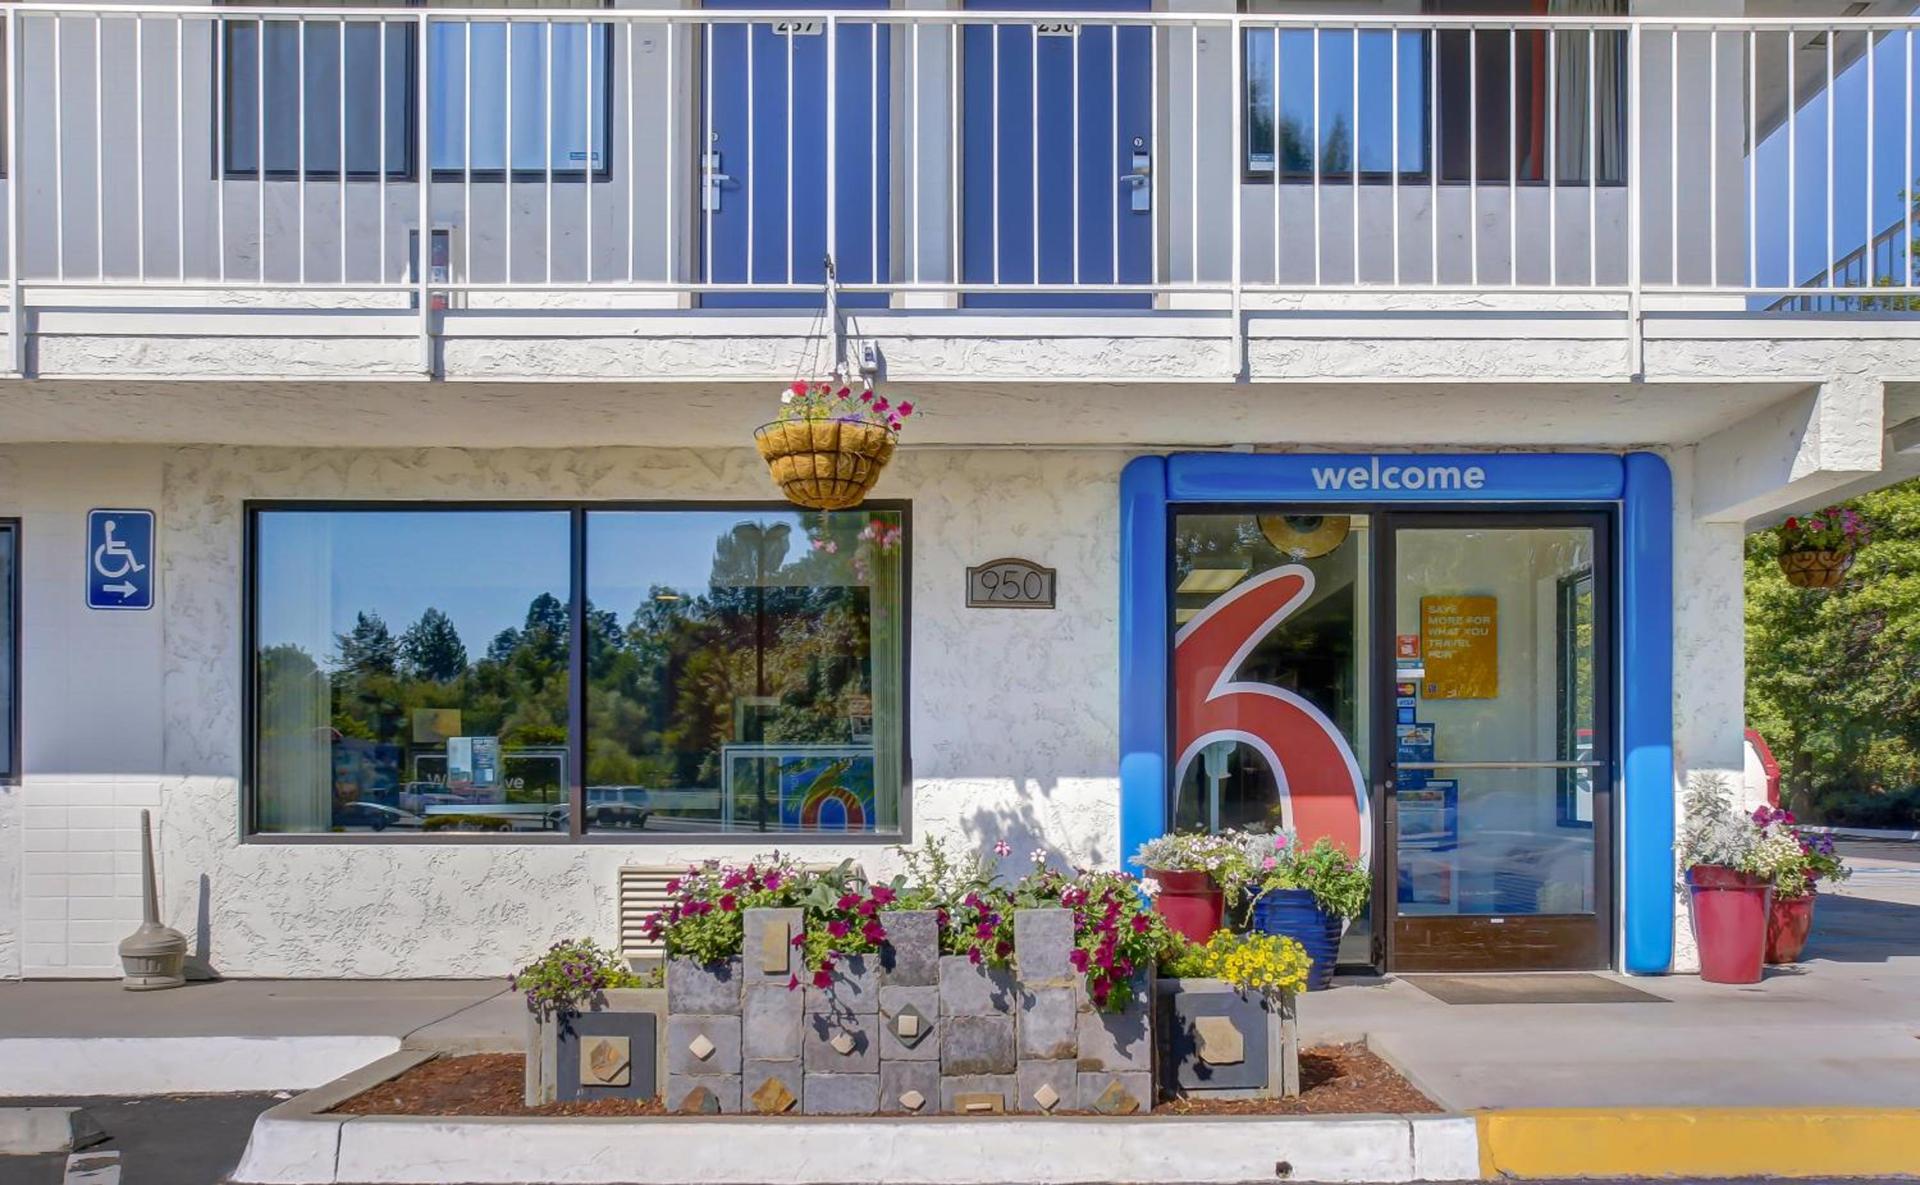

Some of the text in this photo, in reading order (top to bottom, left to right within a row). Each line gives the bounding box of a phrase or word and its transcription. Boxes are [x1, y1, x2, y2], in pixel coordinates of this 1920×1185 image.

[1311, 457, 1486, 491] welcome
[981, 569, 1043, 601] 950
[1428, 616, 1491, 624] MORE FOR
[1428, 627, 1489, 636] WHAT YOU
[1428, 639, 1472, 648] TRAVEL
